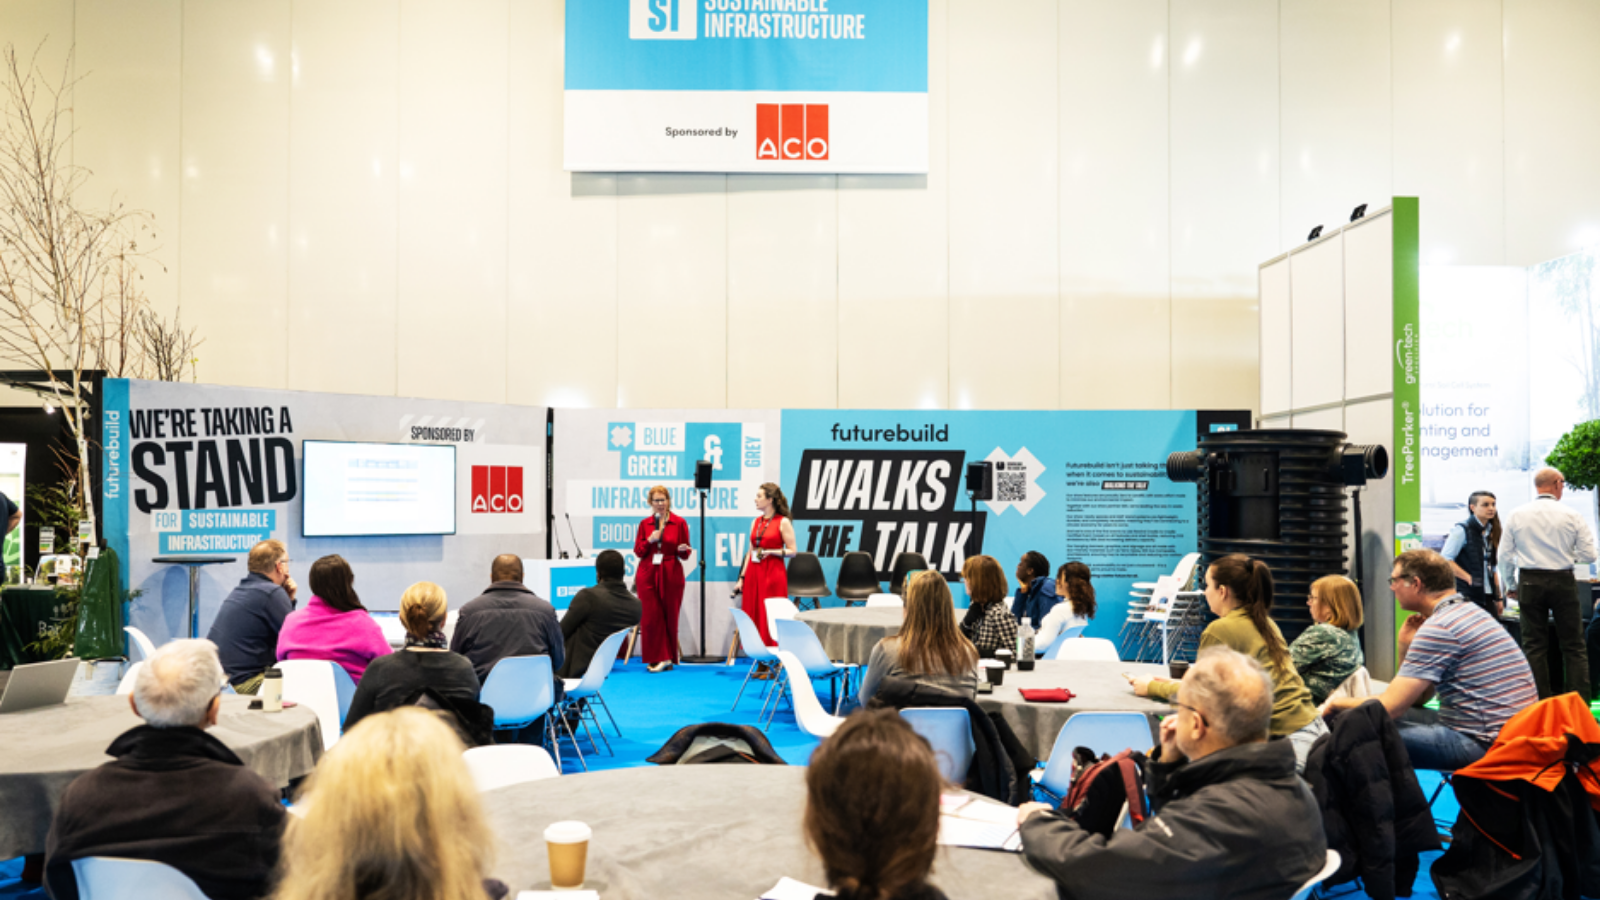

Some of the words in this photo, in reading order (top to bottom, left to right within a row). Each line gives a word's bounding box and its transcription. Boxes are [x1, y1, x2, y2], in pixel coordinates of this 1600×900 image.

[648, 0, 679, 32] SI
[704, 14, 866, 40] INFRASTRUCTURE
[665, 126, 723, 138] Sponsored
[725, 126, 738, 138] by
[757, 137, 828, 159] ACO
[1420, 403, 1464, 417] lution
[1467, 403, 1490, 417] for
[200, 406, 275, 437] TAKING
[279, 406, 293, 434] A
[1420, 423, 1457, 440] nting
[1461, 423, 1490, 437] and
[411, 426, 462, 441] SPONSORED
[463, 428, 475, 442] BY
[643, 427, 676, 445] BLUE
[831, 423, 949, 442] futurebuild
[105, 410, 120, 499] futurebuild
[744, 436, 761, 467] GREY
[1421, 444, 1499, 460] nagement
[131, 437, 297, 514] STAND
[628, 455, 677, 476] GREEN
[1135, 462, 1158, 471] talking
[806, 459, 952, 512] WALKS
[472, 494, 522, 511] ACO
[155, 512, 178, 528] FOR
[189, 512, 269, 528] SUSTAINABLE
[807, 525, 854, 558] THE
[873, 521, 972, 573] TALK
